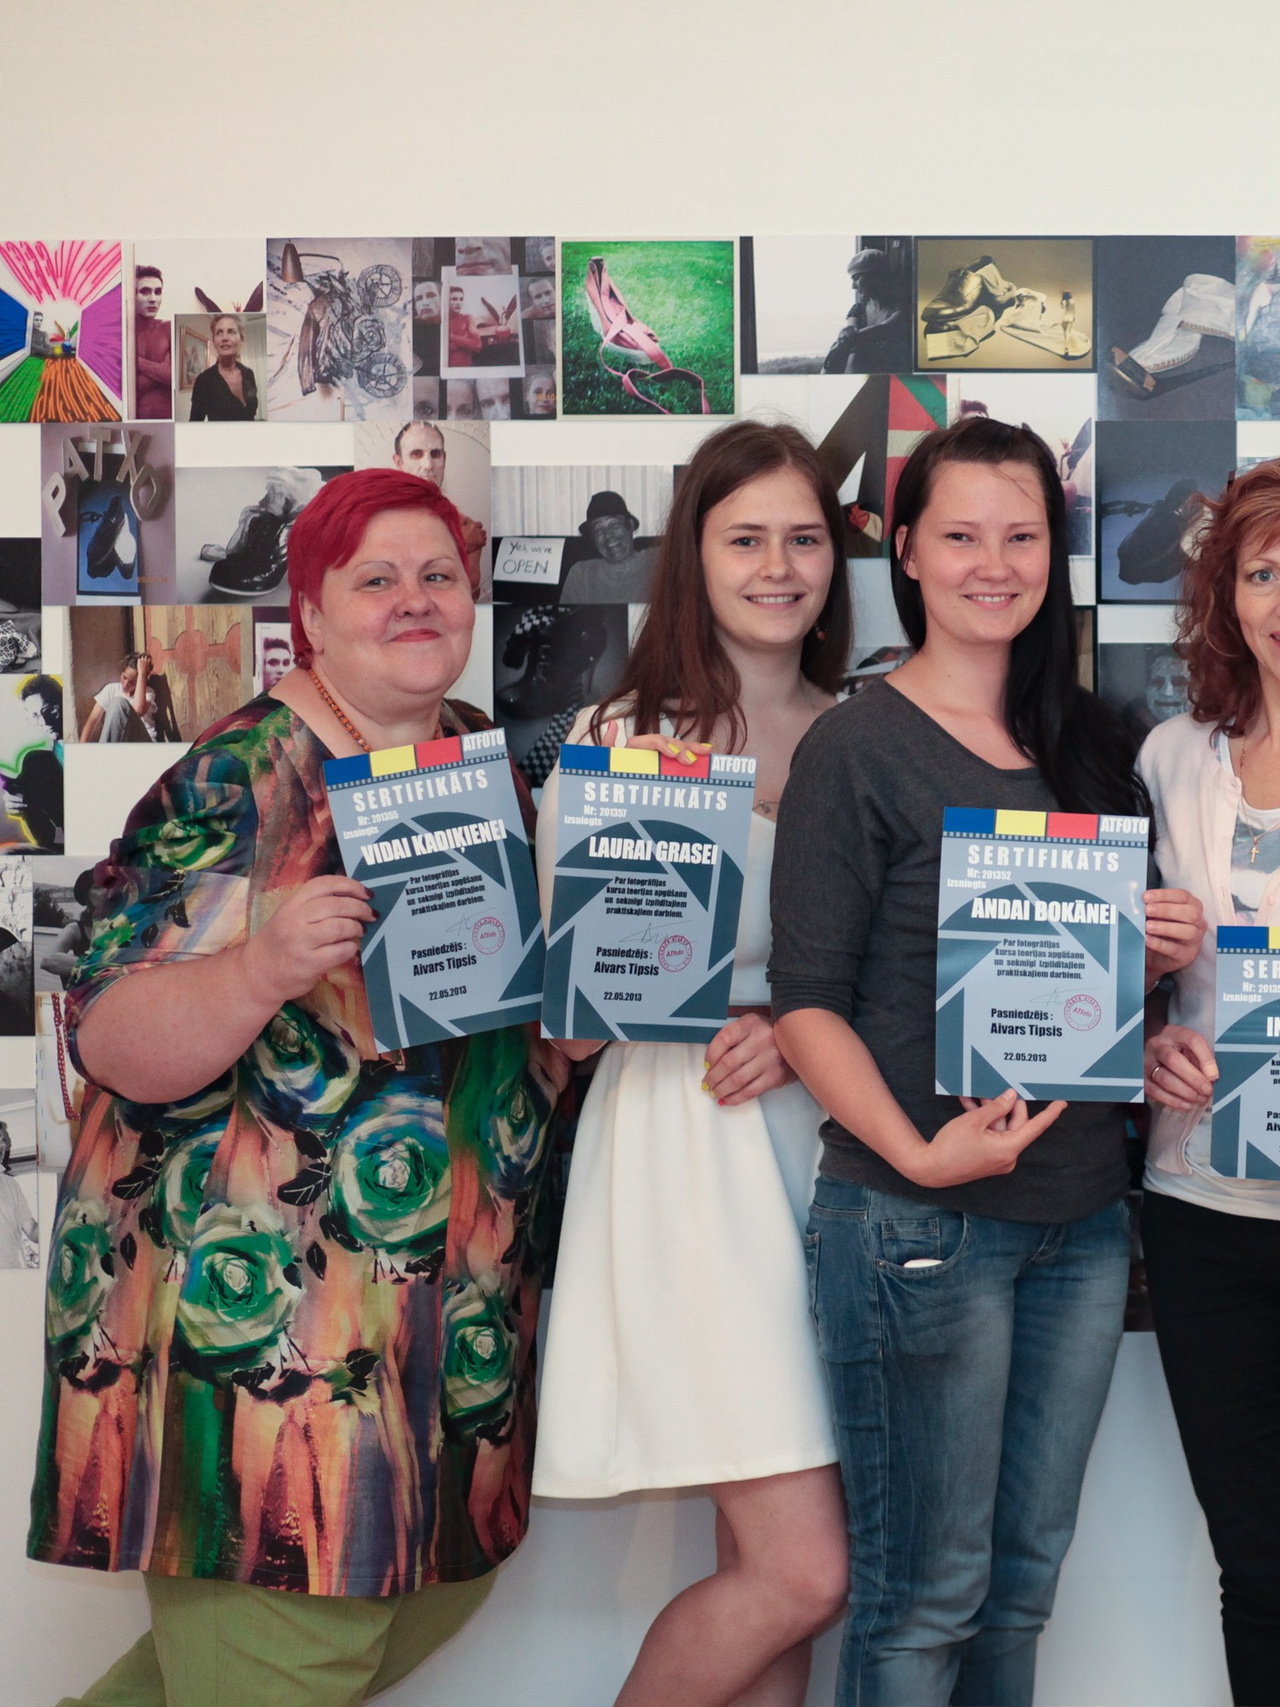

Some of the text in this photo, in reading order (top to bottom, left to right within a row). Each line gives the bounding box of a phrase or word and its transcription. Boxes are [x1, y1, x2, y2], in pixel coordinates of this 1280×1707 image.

[503, 558, 549, 575] OPEN
[461, 729, 504, 751] ATFOTO
[711, 755, 756, 774] ATFOTO
[353, 769, 488, 812] SERTIFIKĀTS
[583, 781, 728, 811] SERTIFIKĀTS
[357, 809, 398, 826] Nr: 201355
[583, 804, 626, 817] Nr: 201357
[1101, 817, 1147, 833] ATFOTO
[361, 819, 507, 866] VIDAI KADIĶIENEI
[588, 836, 718, 865] LAURAI GRASEI
[967, 842, 1119, 871] SERTIFIKĀTS
[409, 875, 421, 884] Par
[614, 876, 626, 884] Par
[967, 867, 1011, 880] Nr: 201352
[405, 884, 424, 895] kursa
[424, 879, 450, 892] teorijas
[606, 886, 625, 894] kursa
[626, 887, 653, 896] teorijas
[406, 897, 416, 905] un
[410, 893, 485, 916] praktiskajiem darbiem.
[605, 906, 683, 917] praktiskajiem darbiem.
[971, 897, 1116, 925] ANDAI BOKĀNEI
[1003, 938, 1015, 946] Par
[995, 947, 1015, 955] kursa
[1017, 948, 1046, 958] teorijas
[412, 953, 477, 976] Aivars Tipsis
[594, 962, 659, 976] Aivars Tipsis
[997, 968, 1082, 979] praktiskajiem darbiem.
[428, 985, 467, 1000] 22.05.2013
[1242, 982, 1255, 991] Nr:
[603, 991, 642, 1001] 22.05.2013
[990, 1023, 1062, 1037] Aivars Tipsis
[1003, 1052, 1046, 1062] 22.05.2013
